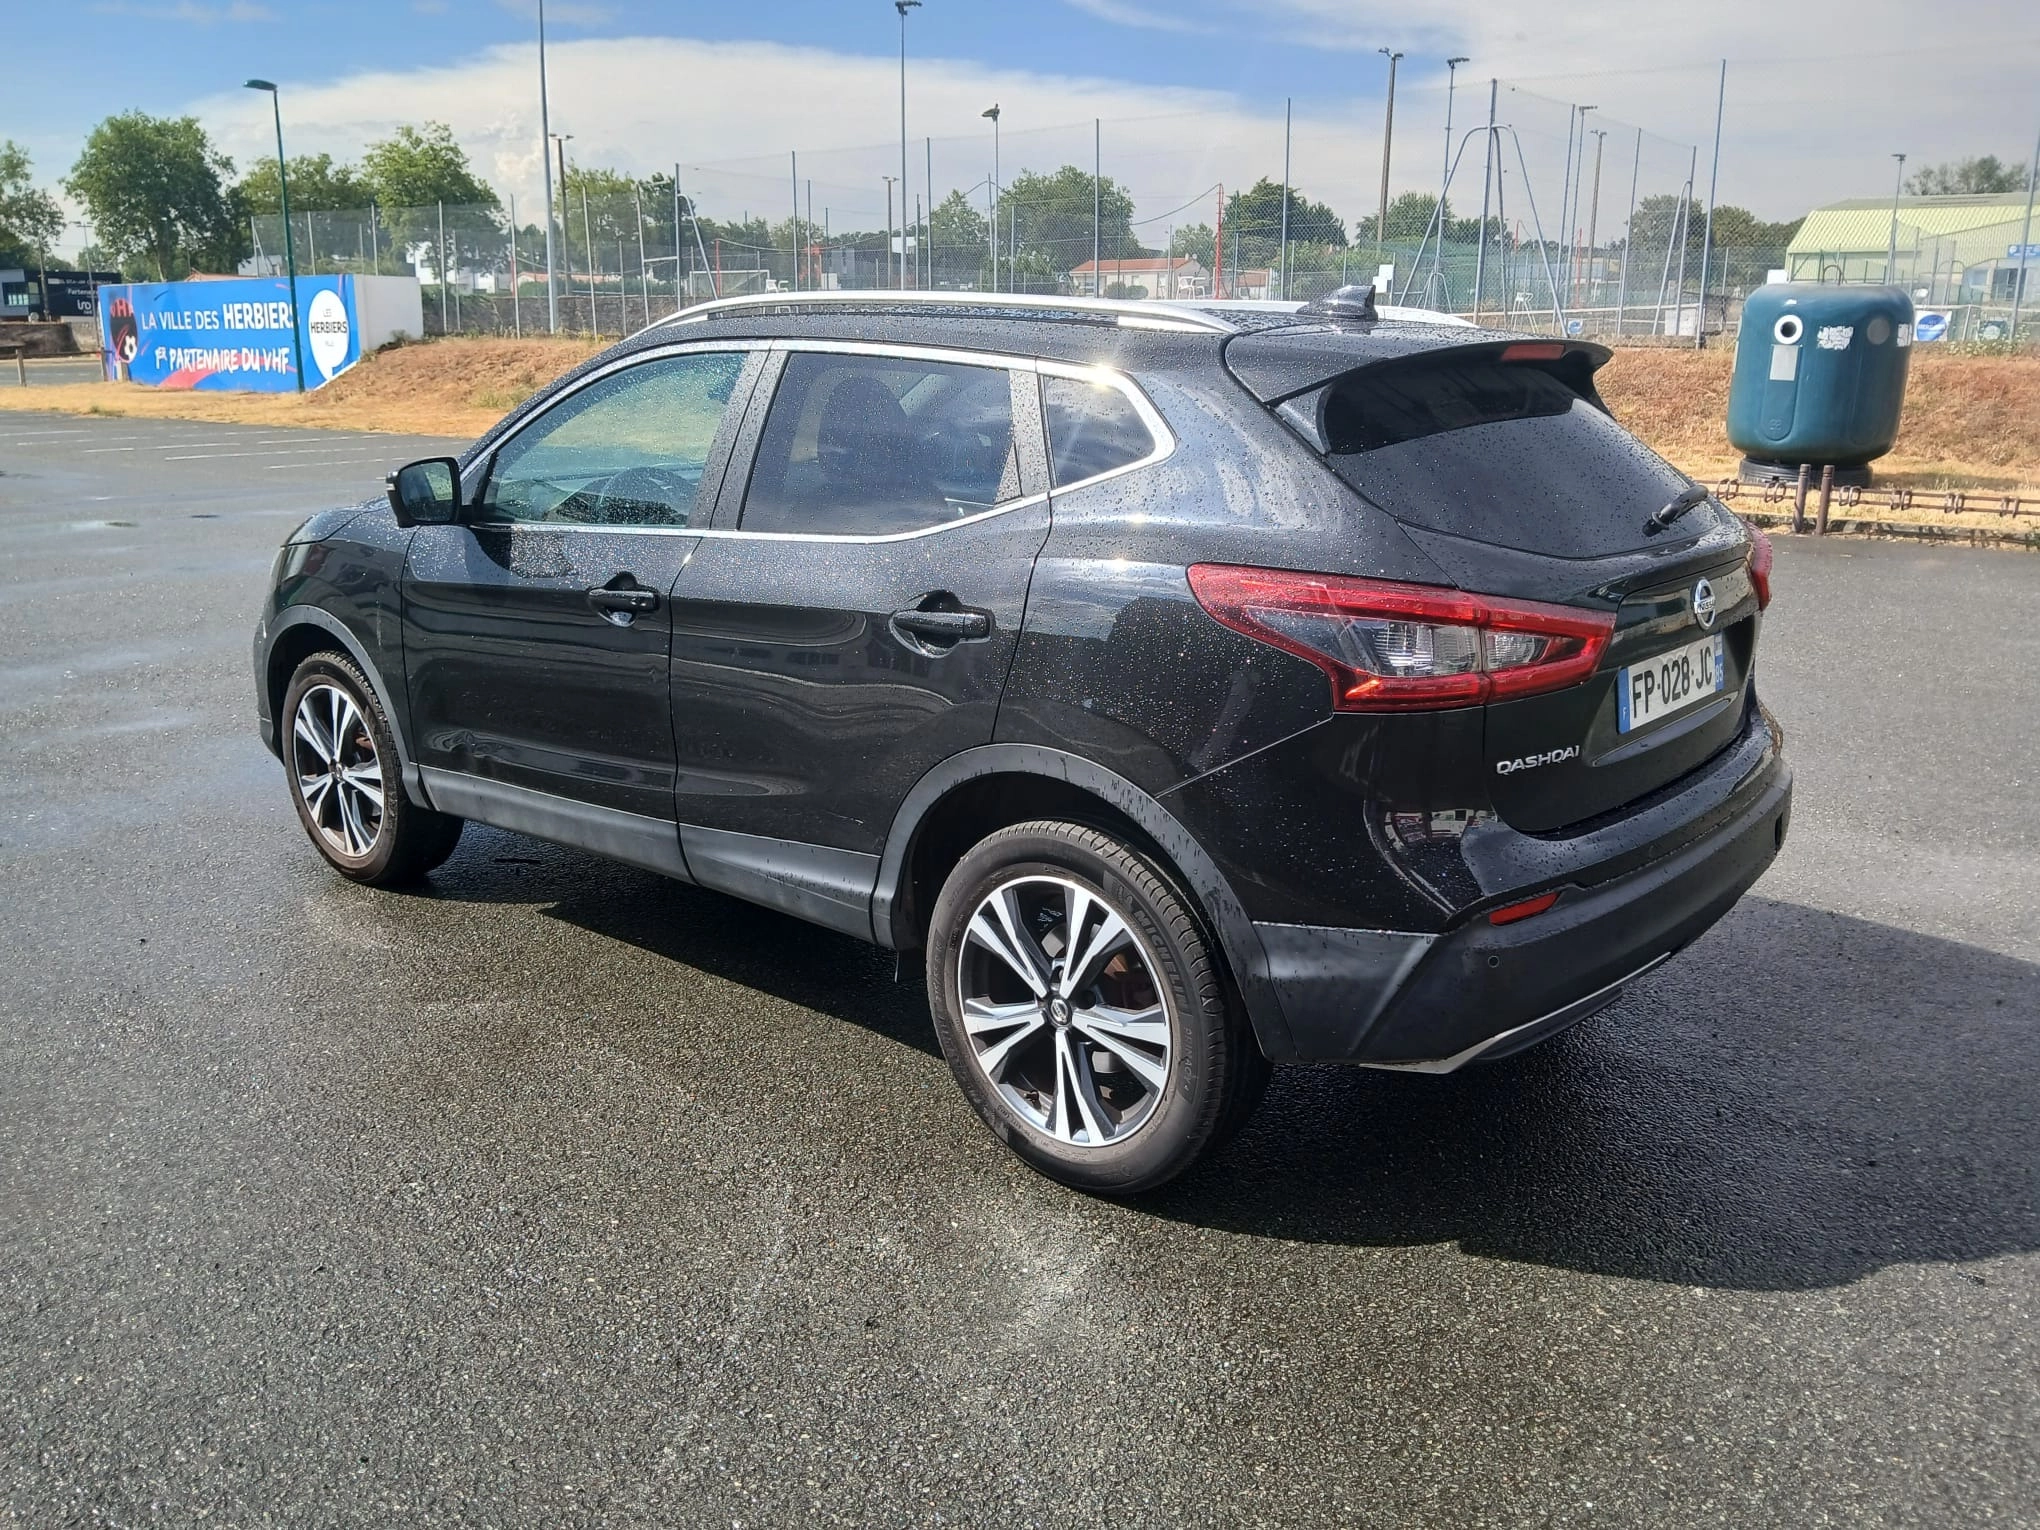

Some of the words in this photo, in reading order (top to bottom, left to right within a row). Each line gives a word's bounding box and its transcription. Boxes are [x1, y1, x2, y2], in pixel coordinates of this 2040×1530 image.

[141, 311, 158, 330] LA
[158, 311, 192, 330] VILLE
[194, 310, 219, 330] DES
[311, 321, 347, 334] HERBIERS
[169, 347, 239, 374] PARTENAIRE
[241, 347, 260, 373] DU
[262, 347, 290, 375] VHF
[1496, 745, 1580, 776] QASHQAI
[1131, 908, 1191, 1014] MICHELIN
